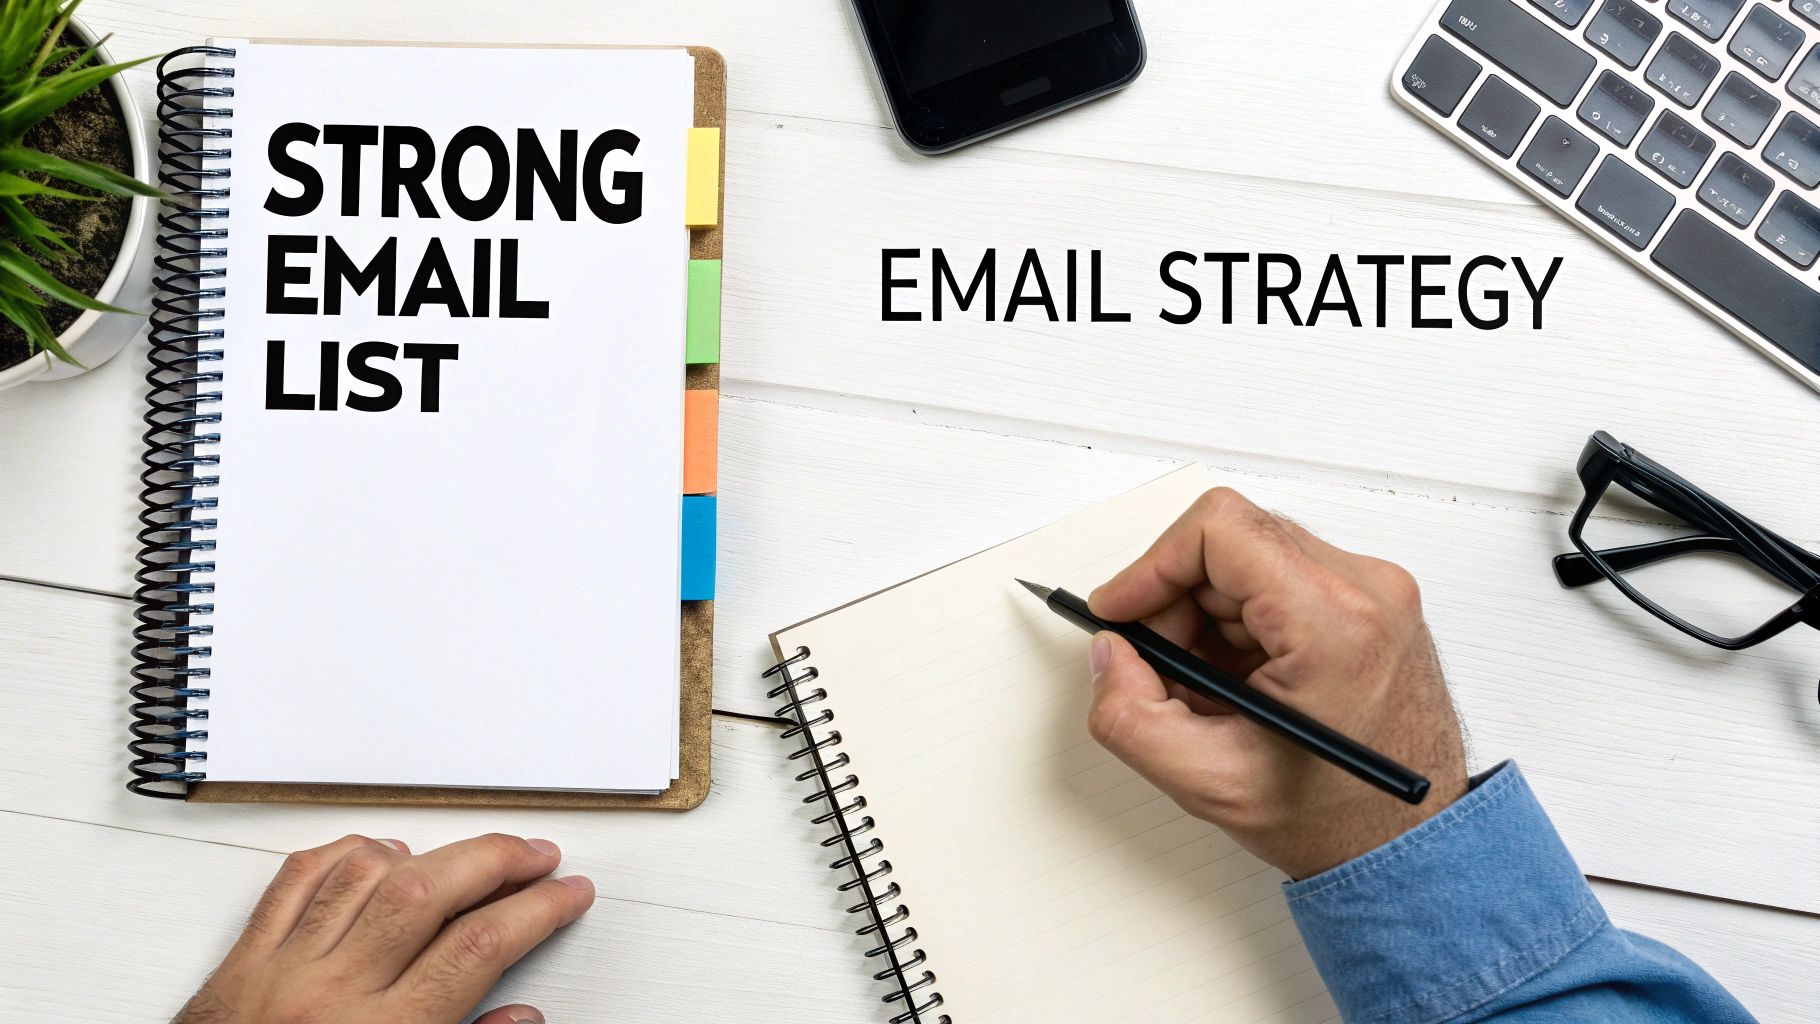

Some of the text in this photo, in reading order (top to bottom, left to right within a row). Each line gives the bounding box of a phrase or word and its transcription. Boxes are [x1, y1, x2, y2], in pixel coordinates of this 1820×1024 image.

[263, 121, 644, 224] STRONG
[265, 234, 550, 318] EMAIL
[265, 339, 459, 413] LIST
